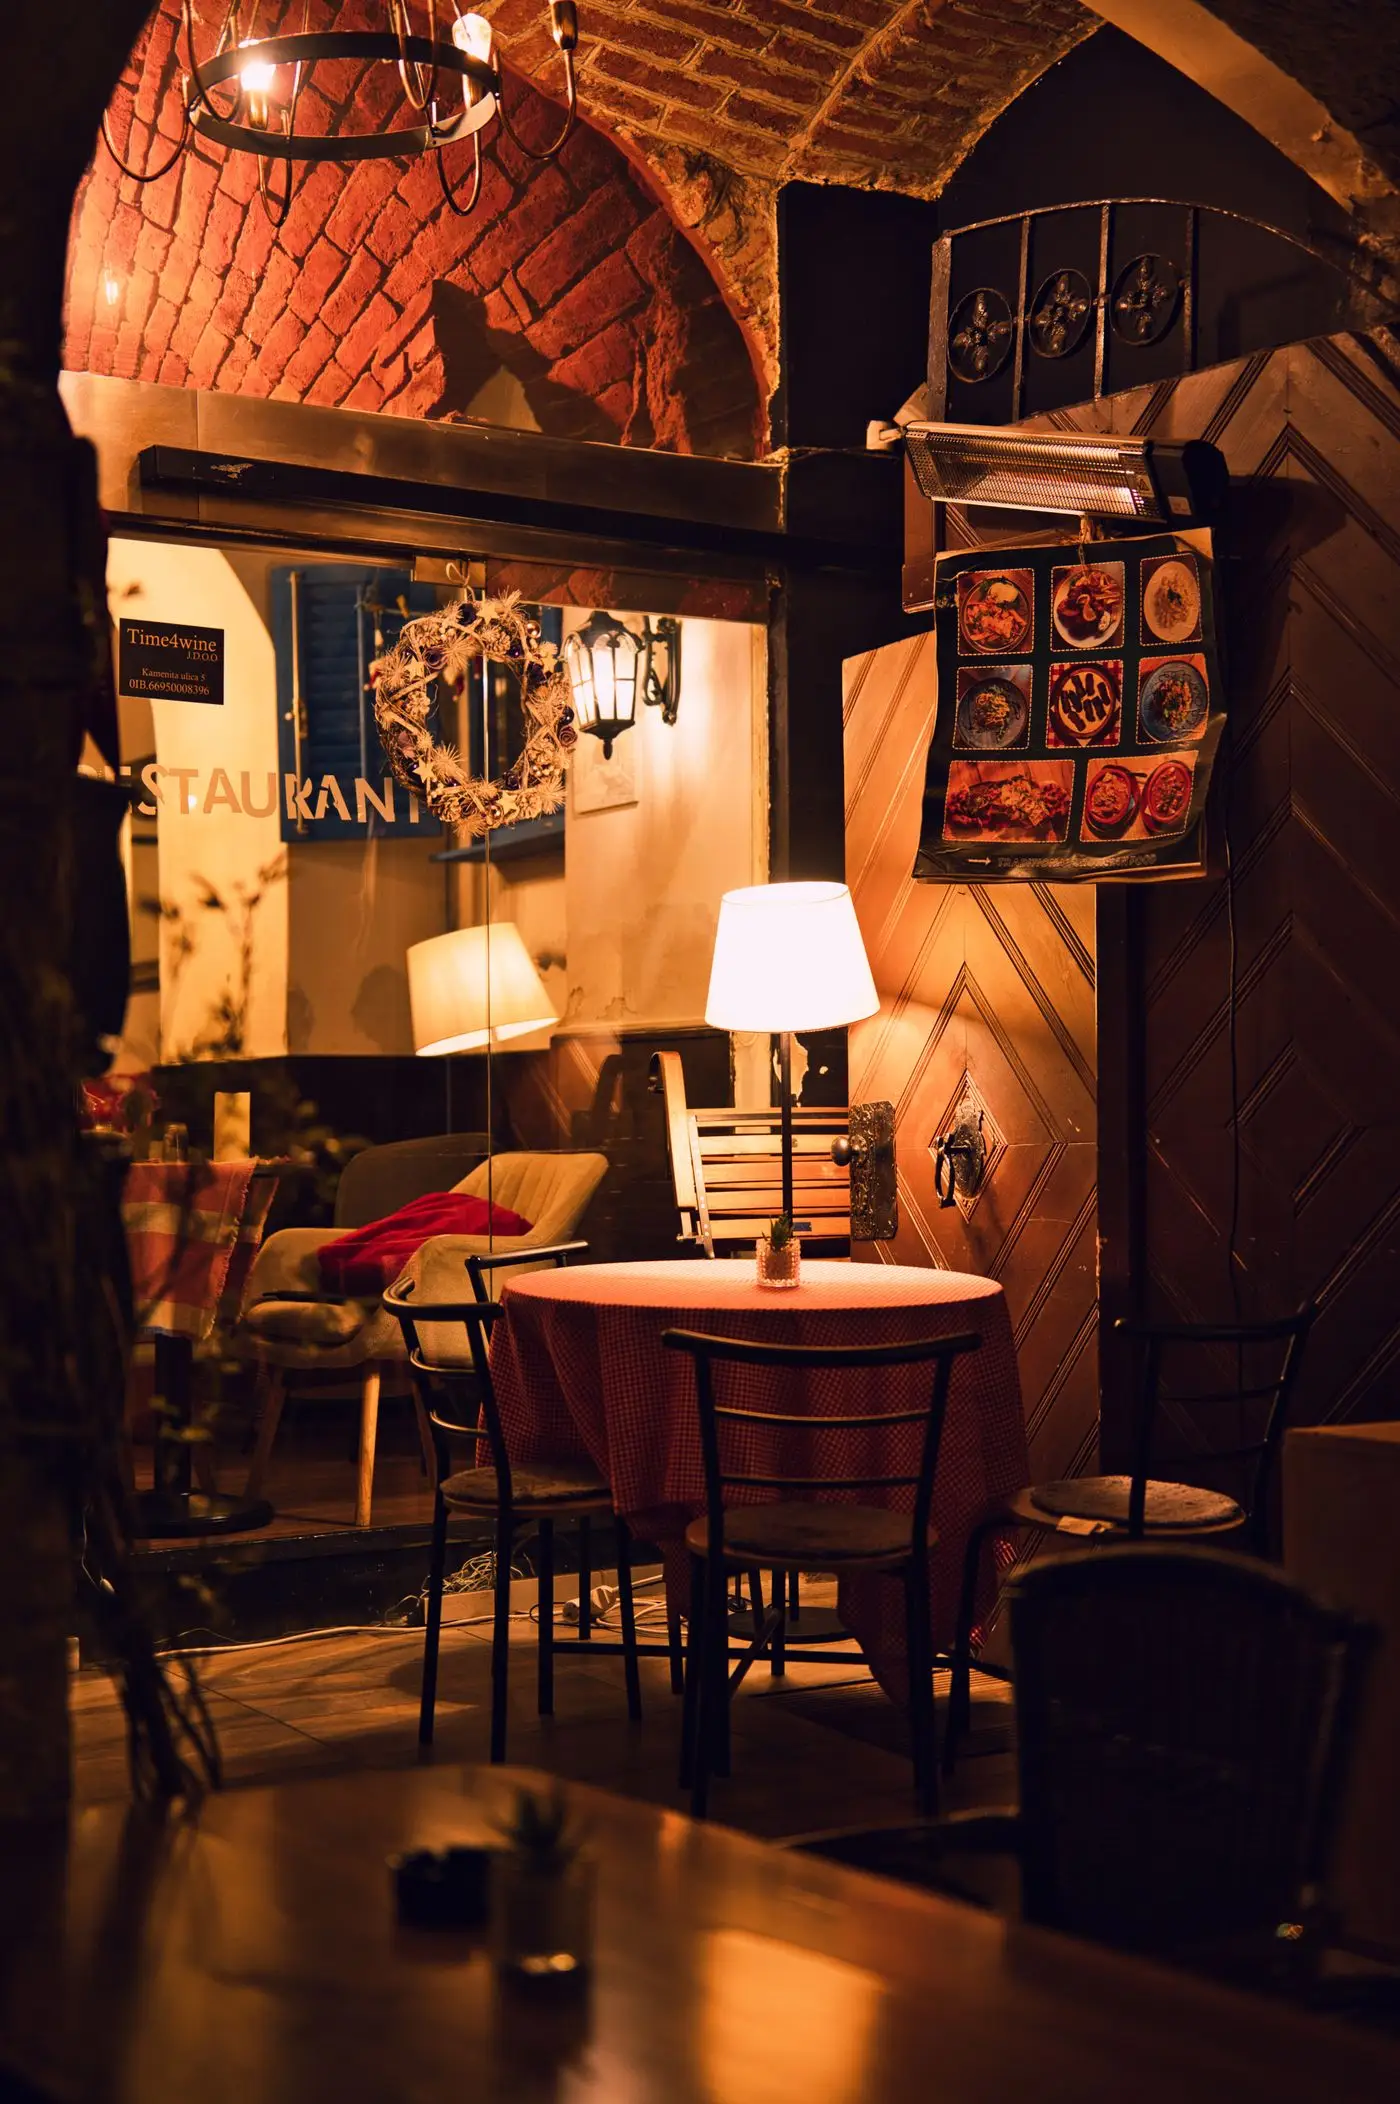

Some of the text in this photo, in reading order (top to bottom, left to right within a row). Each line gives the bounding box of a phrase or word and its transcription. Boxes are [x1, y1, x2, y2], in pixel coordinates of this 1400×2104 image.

[127, 628, 217, 651] Time4wine
[142, 668, 179, 679] Kamenita
[181, 672, 198, 680] ulica
